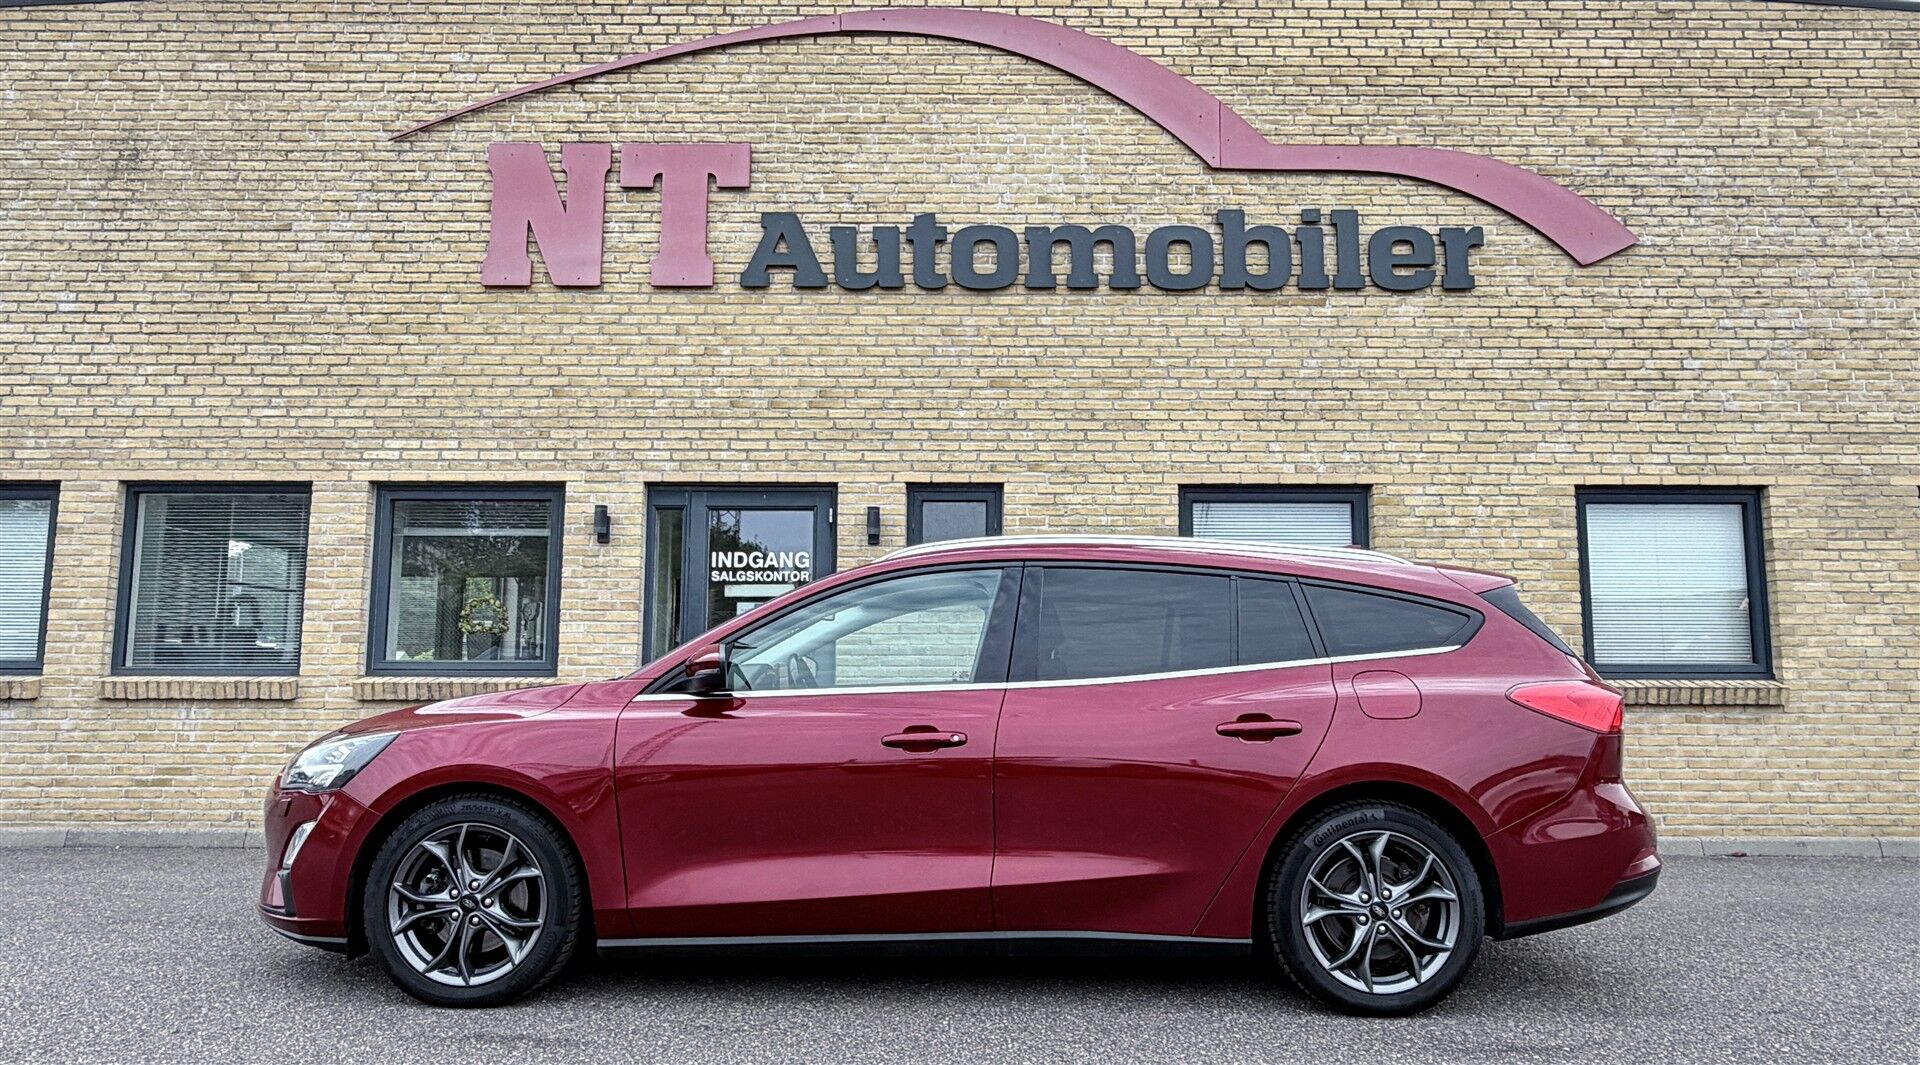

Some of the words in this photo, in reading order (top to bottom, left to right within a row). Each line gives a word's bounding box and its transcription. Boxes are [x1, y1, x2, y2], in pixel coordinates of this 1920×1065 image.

[481, 142, 751, 287] NT
[740, 208, 1484, 291] Automobiler
[711, 551, 810, 569] INDGANG
[711, 570, 810, 582] SALGSKONTOR
[1313, 813, 1369, 847] Continental
